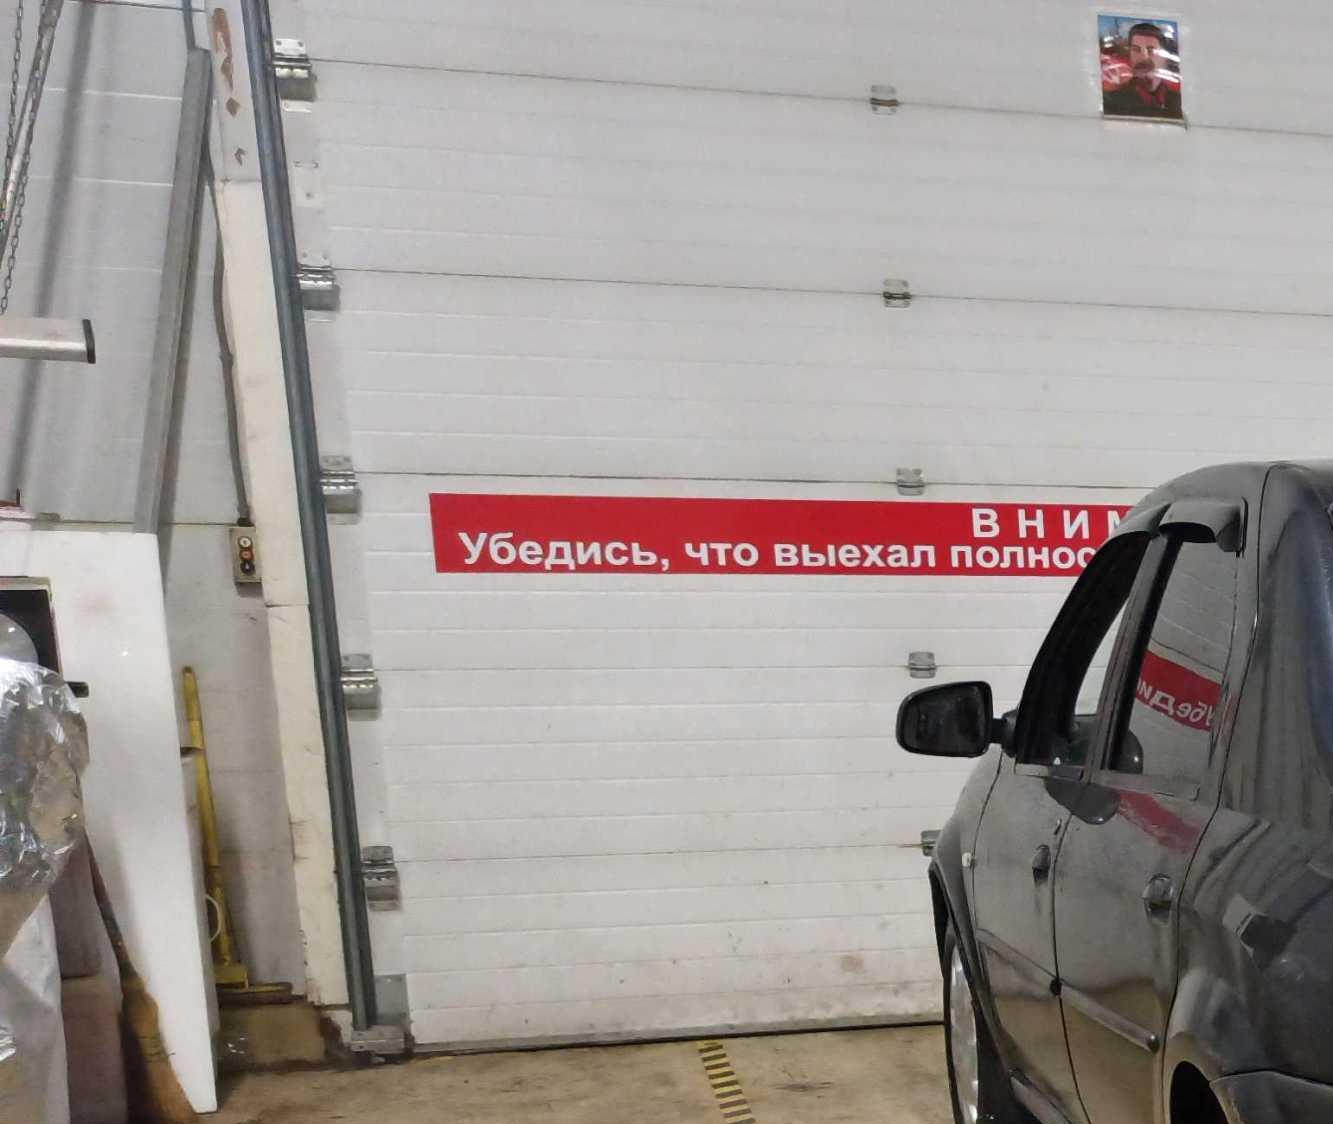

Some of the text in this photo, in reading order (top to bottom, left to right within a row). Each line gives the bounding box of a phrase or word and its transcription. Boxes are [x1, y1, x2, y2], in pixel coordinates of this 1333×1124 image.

[459, 532, 671, 571] Убедись,
[684, 544, 759, 567] что
[773, 544, 936, 568] выехал
